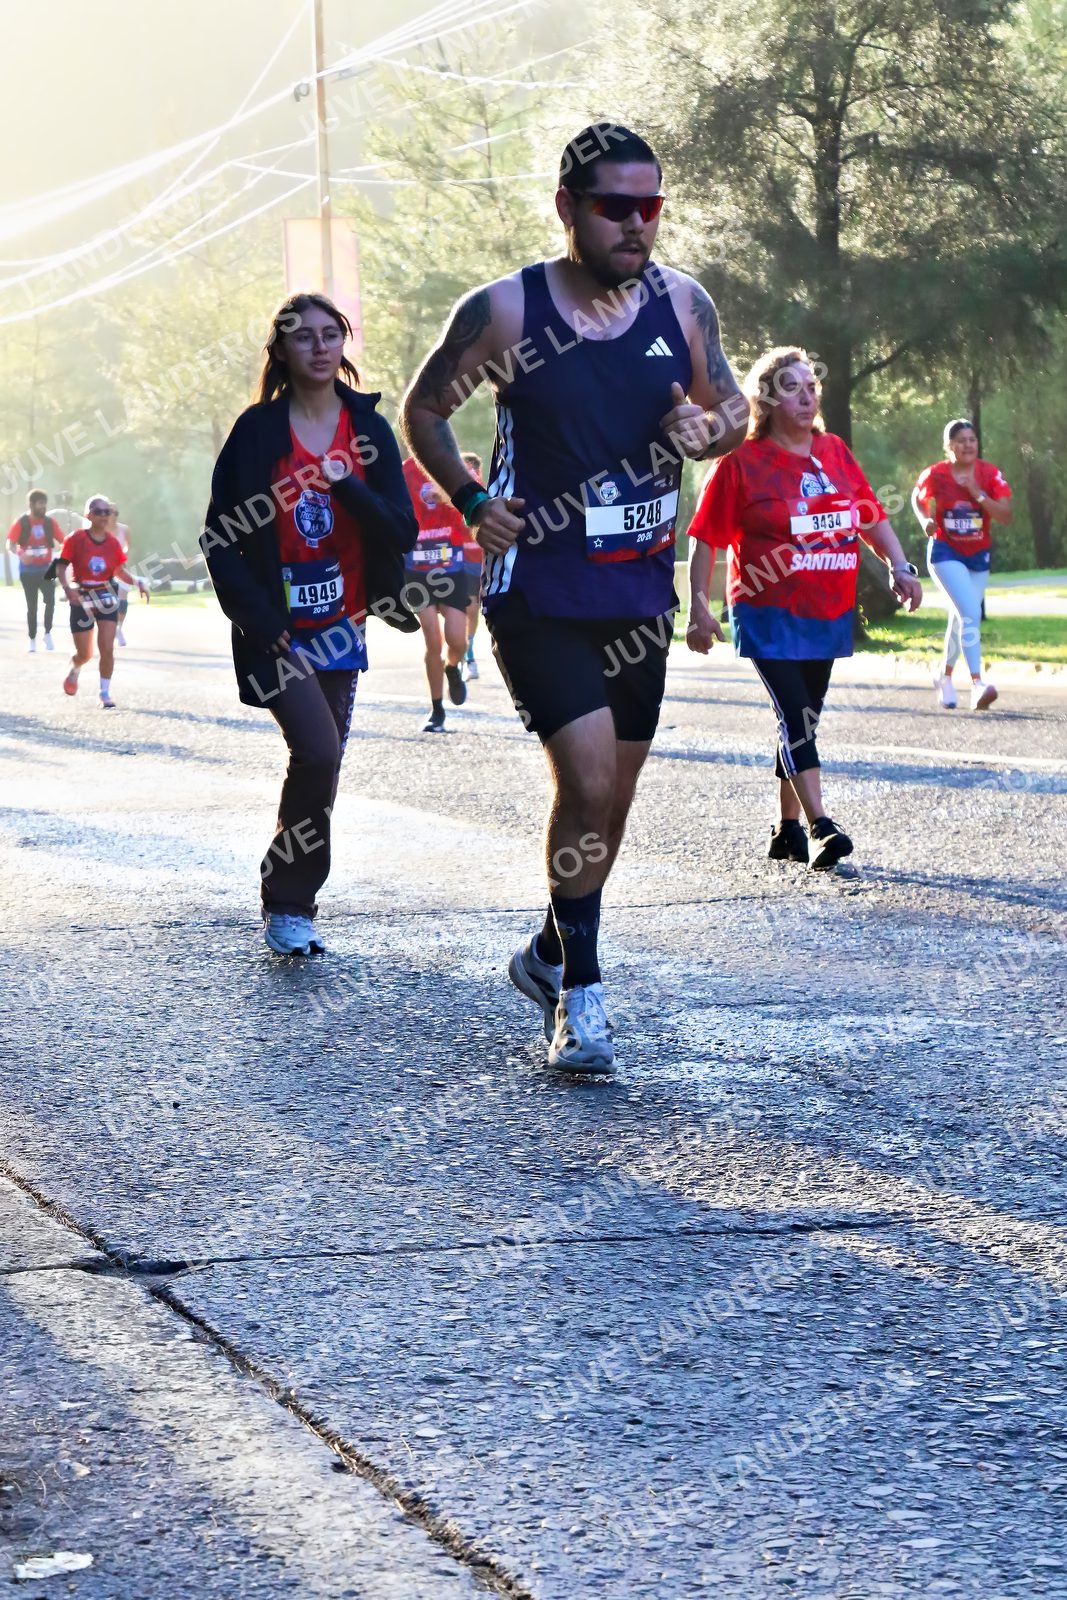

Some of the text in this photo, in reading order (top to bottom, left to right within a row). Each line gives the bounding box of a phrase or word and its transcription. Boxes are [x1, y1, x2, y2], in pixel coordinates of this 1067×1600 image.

[623, 499, 662, 531] 5248
[812, 513, 842, 531] 3434
[790, 552, 858, 570] SANTIAGO
[298, 578, 338, 605] 4949
